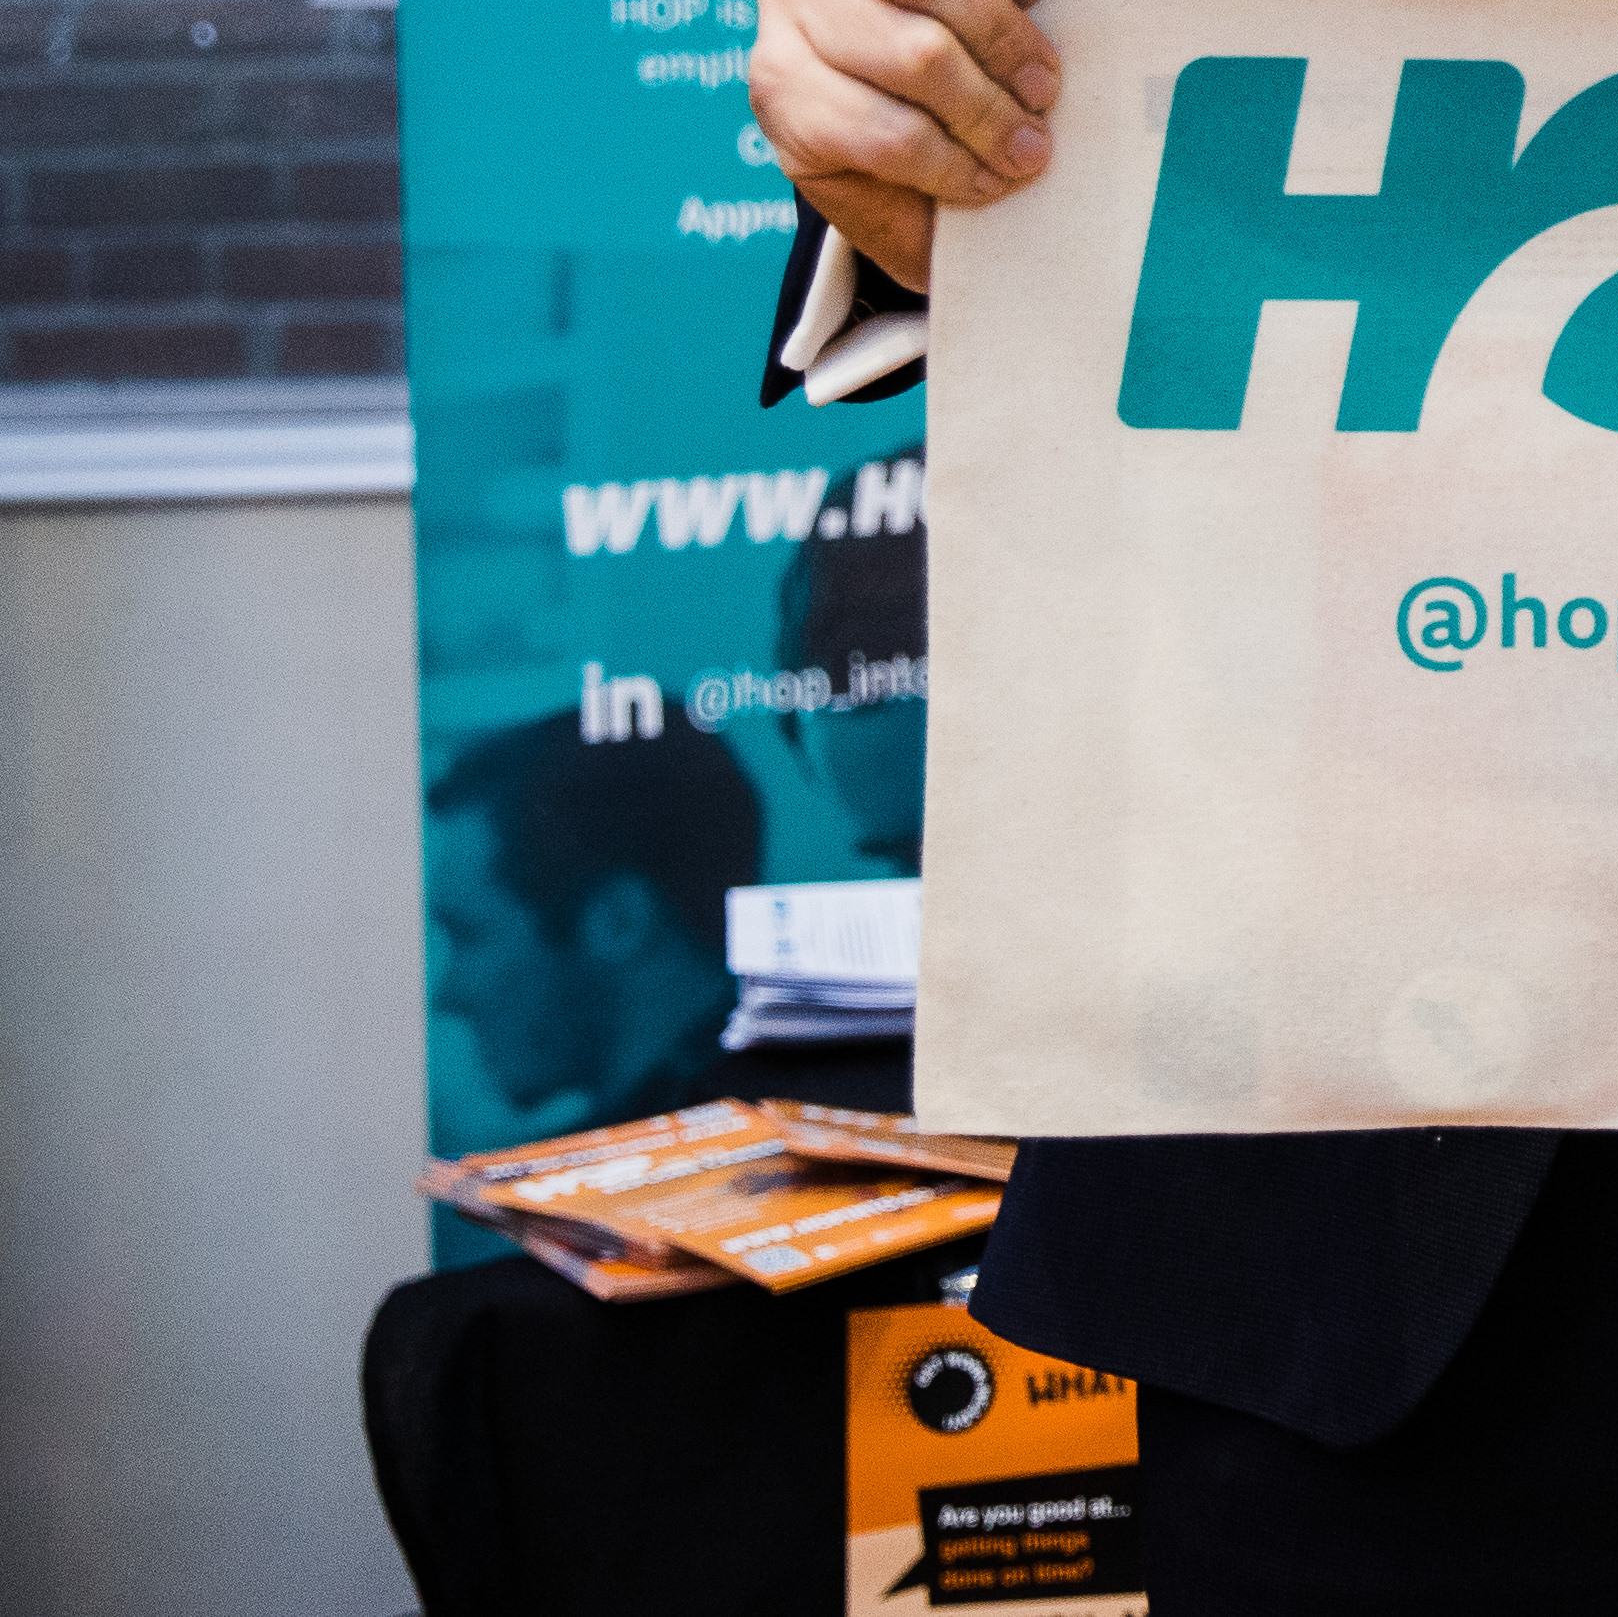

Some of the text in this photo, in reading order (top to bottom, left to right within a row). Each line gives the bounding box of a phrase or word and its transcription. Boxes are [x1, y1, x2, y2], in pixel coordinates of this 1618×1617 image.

[562, 457, 926, 557] WWW.H
[937, 1503, 981, 1531] Are
[981, 1503, 1026, 1532] you
